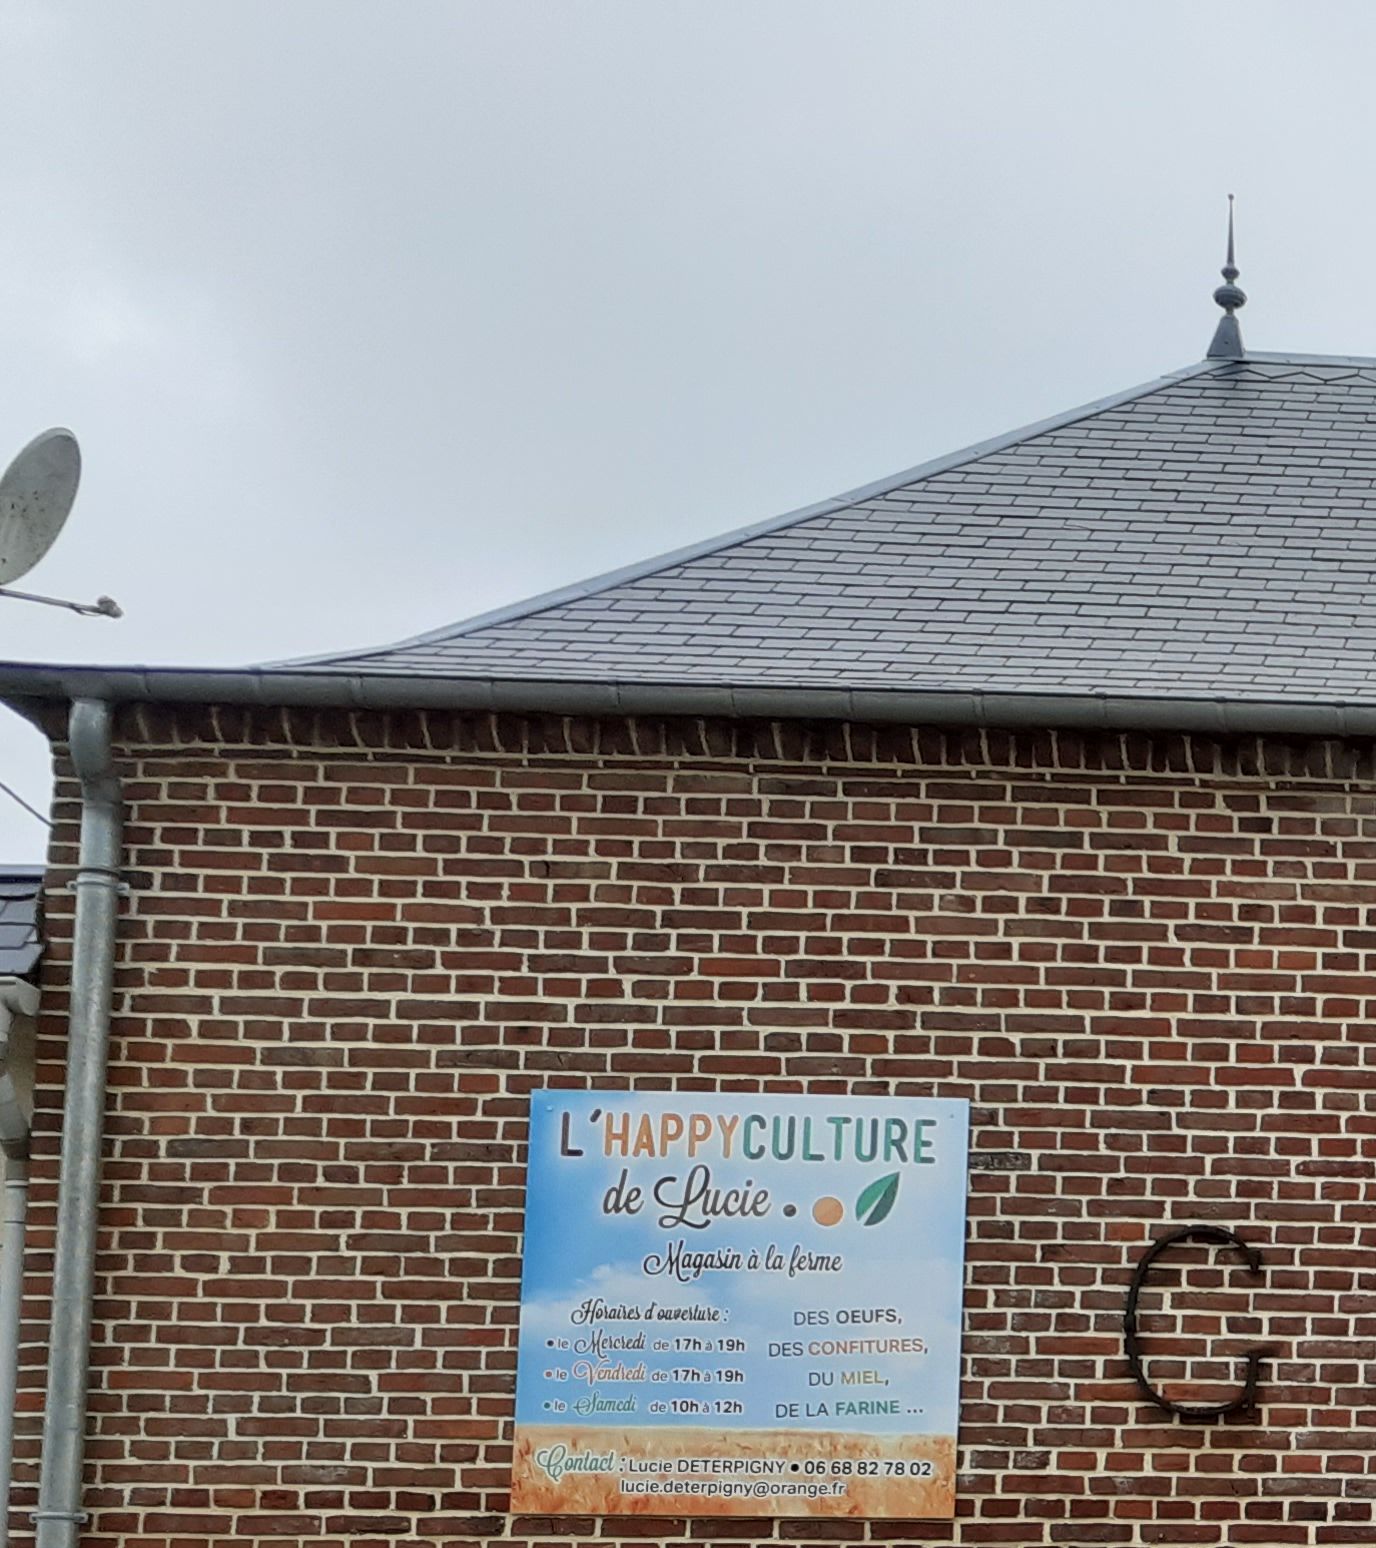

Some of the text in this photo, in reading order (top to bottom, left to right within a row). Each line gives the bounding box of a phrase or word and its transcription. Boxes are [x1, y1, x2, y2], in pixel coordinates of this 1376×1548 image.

[560, 1108, 938, 1165] L'HAPPYCULTURE
[602, 1164, 773, 1230] de Lucie
[643, 1239, 843, 1282] Magasin à la ferme
[571, 1298, 641, 1325] Horaires
[794, 1308, 902, 1326] DES OEUFS,
[557, 1328, 745, 1359] le Mercredi de 17h à 19h
[768, 1338, 928, 1358] DES CONFITURES,
[556, 1359, 744, 1385] le Vendredi de 17h à 19h
[808, 1370, 889, 1387] DU MIEL,
[554, 1392, 743, 1415] le Samedi de 10h à 12h
[775, 1403, 800, 1419] DE
[806, 1402, 829, 1418] LA
[836, 1400, 901, 1416] FARINE
[536, 1445, 615, 1482] Contact
[628, 1459, 673, 1474] Lucie
[677, 1459, 786, 1475] DETERPIGNY
[804, 1461, 826, 1475] 06
[831, 1461, 852, 1476] 68
[857, 1461, 879, 1476] 82
[884, 1462, 905, 1476] 78
[909, 1462, 931, 1477] 02
[621, 1479, 846, 1498] lucie.deterpigny@orange.fr
